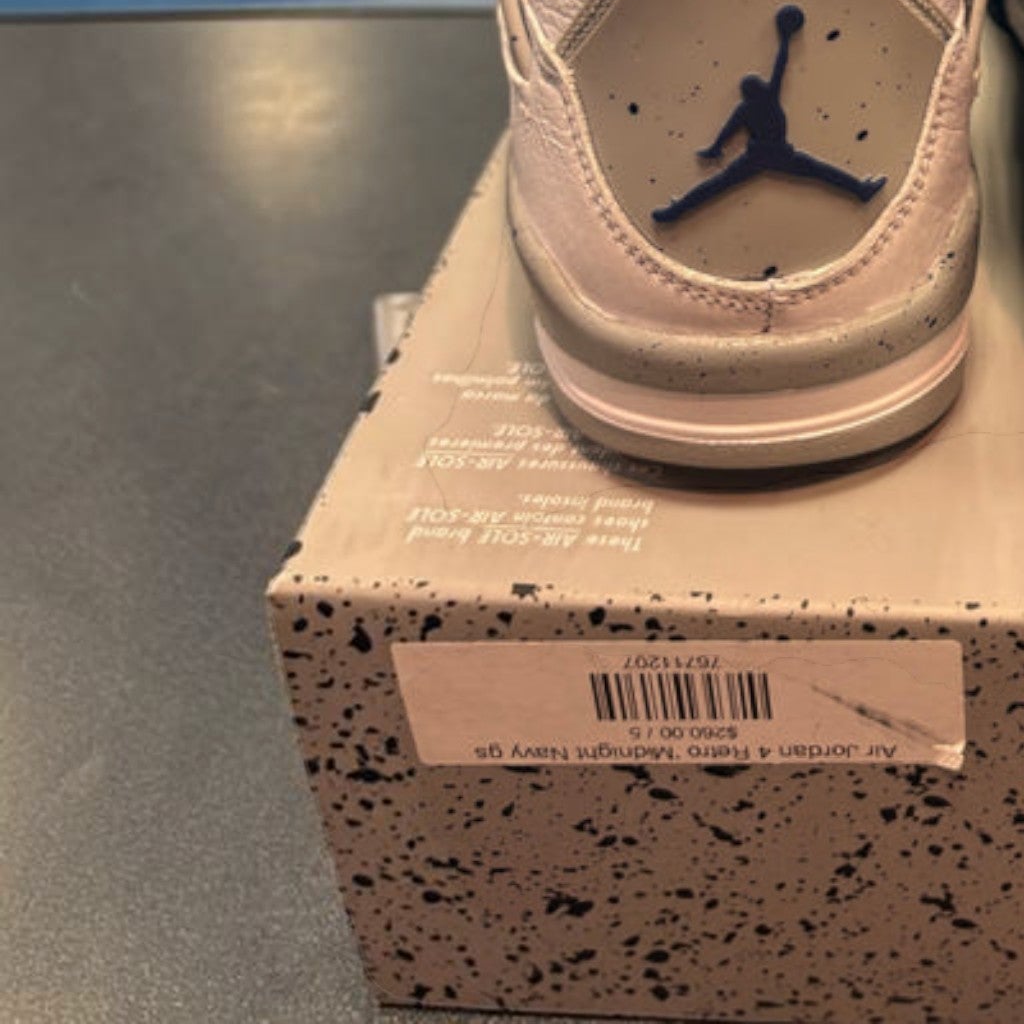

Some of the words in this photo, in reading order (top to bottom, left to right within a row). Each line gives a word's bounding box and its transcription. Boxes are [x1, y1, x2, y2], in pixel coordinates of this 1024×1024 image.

[592, 497, 655, 515] brand
[405, 506, 507, 526] AIR-SOLE
[595, 515, 649, 532] shoes
[405, 525, 472, 545] brand
[477, 526, 580, 549] AIR-SOLE
[585, 533, 643, 553] These
[628, 726, 641, 740] 5
[473, 742, 503, 759] gs
[511, 744, 570, 762] Navy
[687, 745, 749, 761] Retro
[758, 746, 772, 760] 4
[778, 744, 859, 760] Jordan
[866, 745, 897, 759] Air
